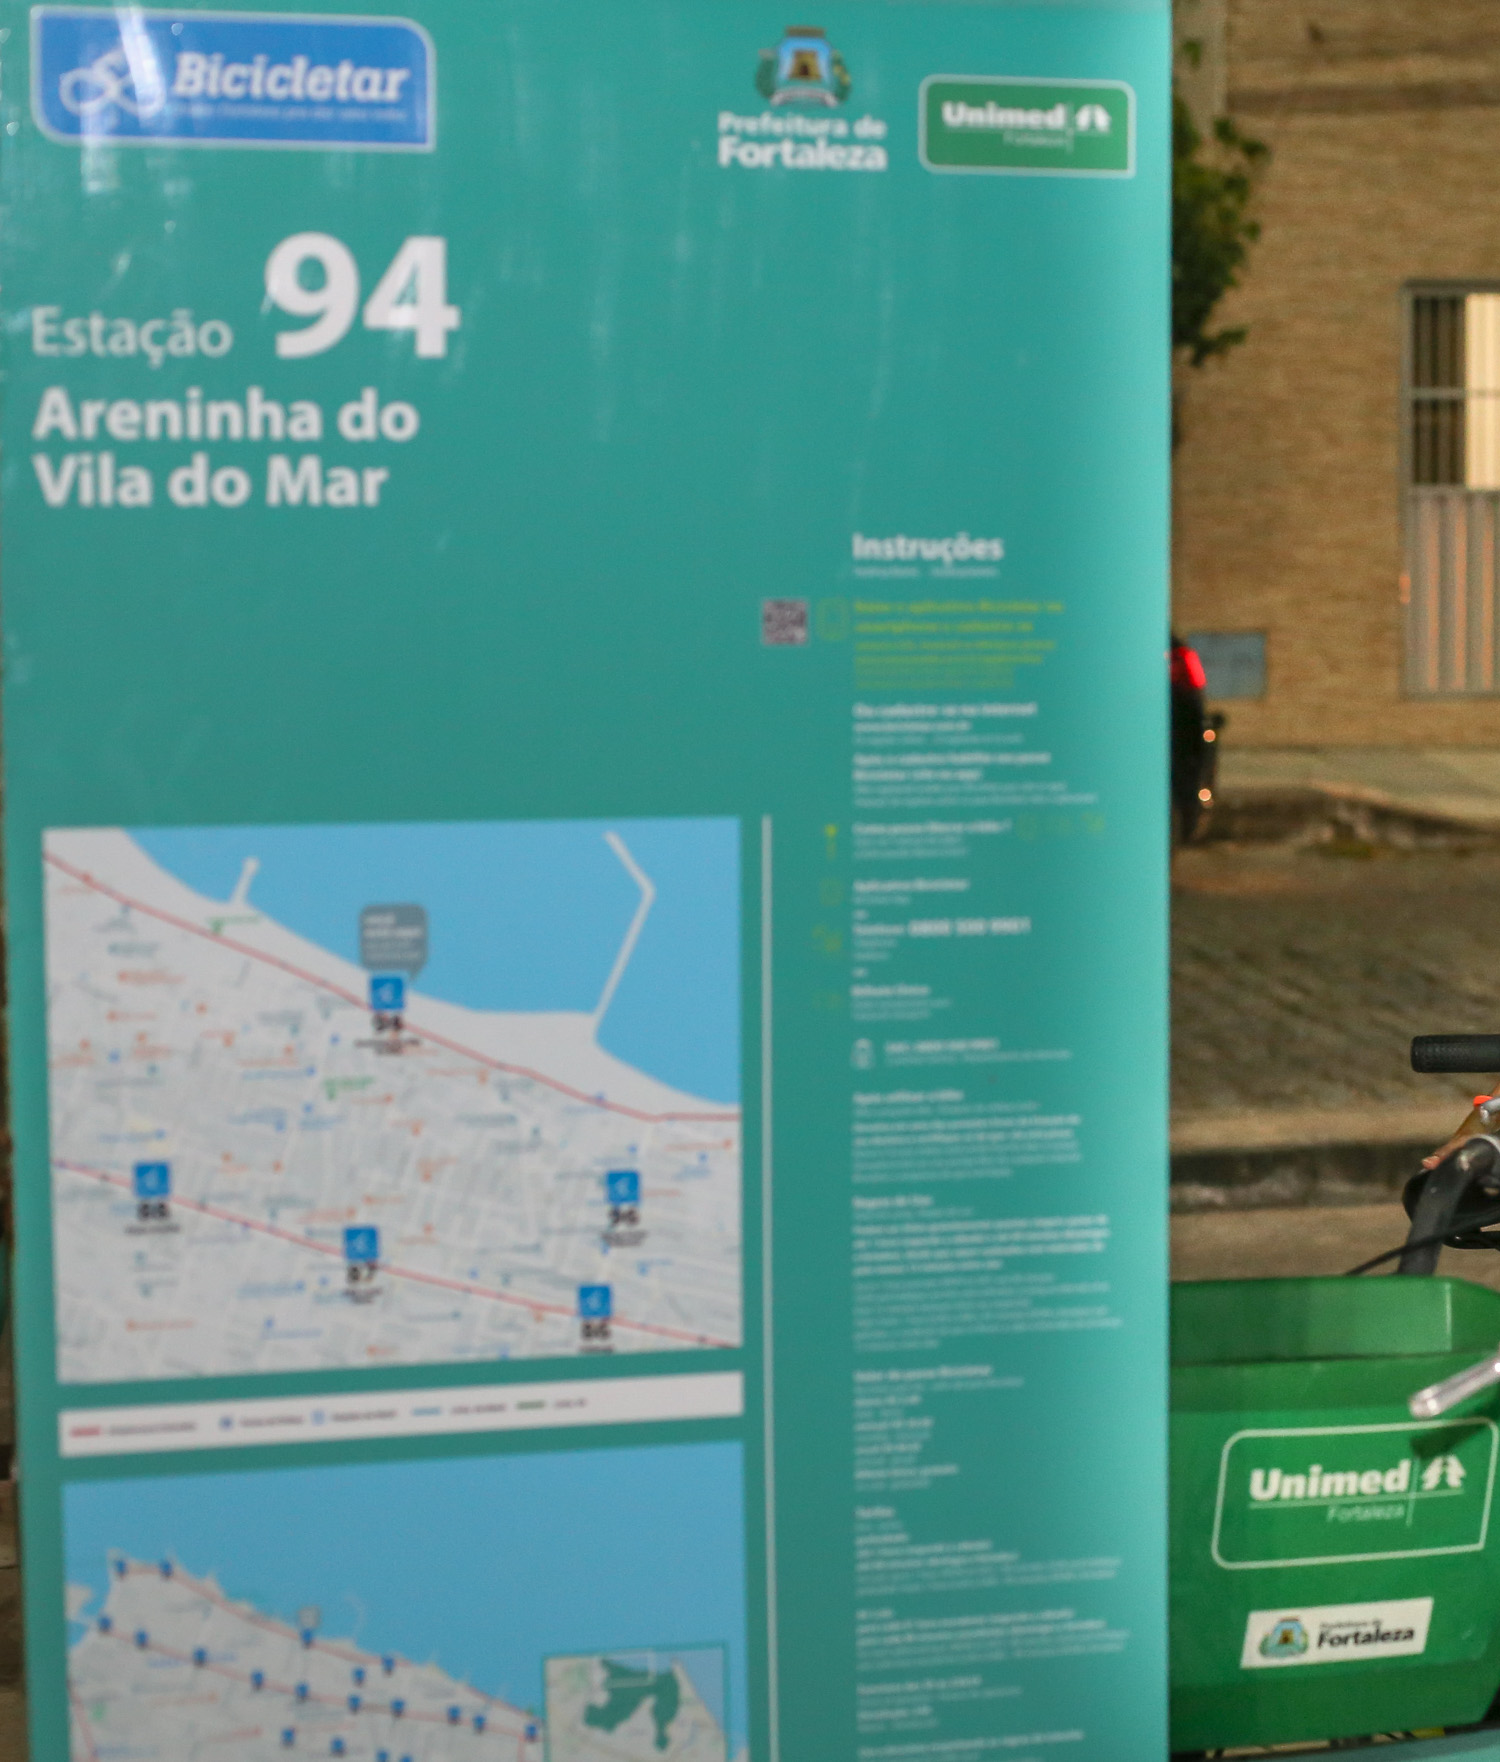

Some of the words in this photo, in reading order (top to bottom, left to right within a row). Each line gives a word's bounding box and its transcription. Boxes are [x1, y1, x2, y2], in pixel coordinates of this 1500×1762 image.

[172, 52, 411, 102] Bicicletar
[717, 111, 848, 138] Prefeitura
[853, 115, 888, 139] de
[941, 100, 1067, 130] Unimed
[717, 136, 889, 172] Fortaleza
[31, 306, 234, 368] Estação
[263, 231, 461, 359] 94
[32, 386, 324, 442] Areninha
[337, 386, 420, 442] do
[32, 451, 154, 508] Vila
[168, 452, 252, 507] do
[265, 454, 390, 508] Mar
[852, 532, 1005, 567] Instruções
[1250, 1458, 1412, 1501] Unimed
[1317, 1627, 1415, 1650] Fortaleza
